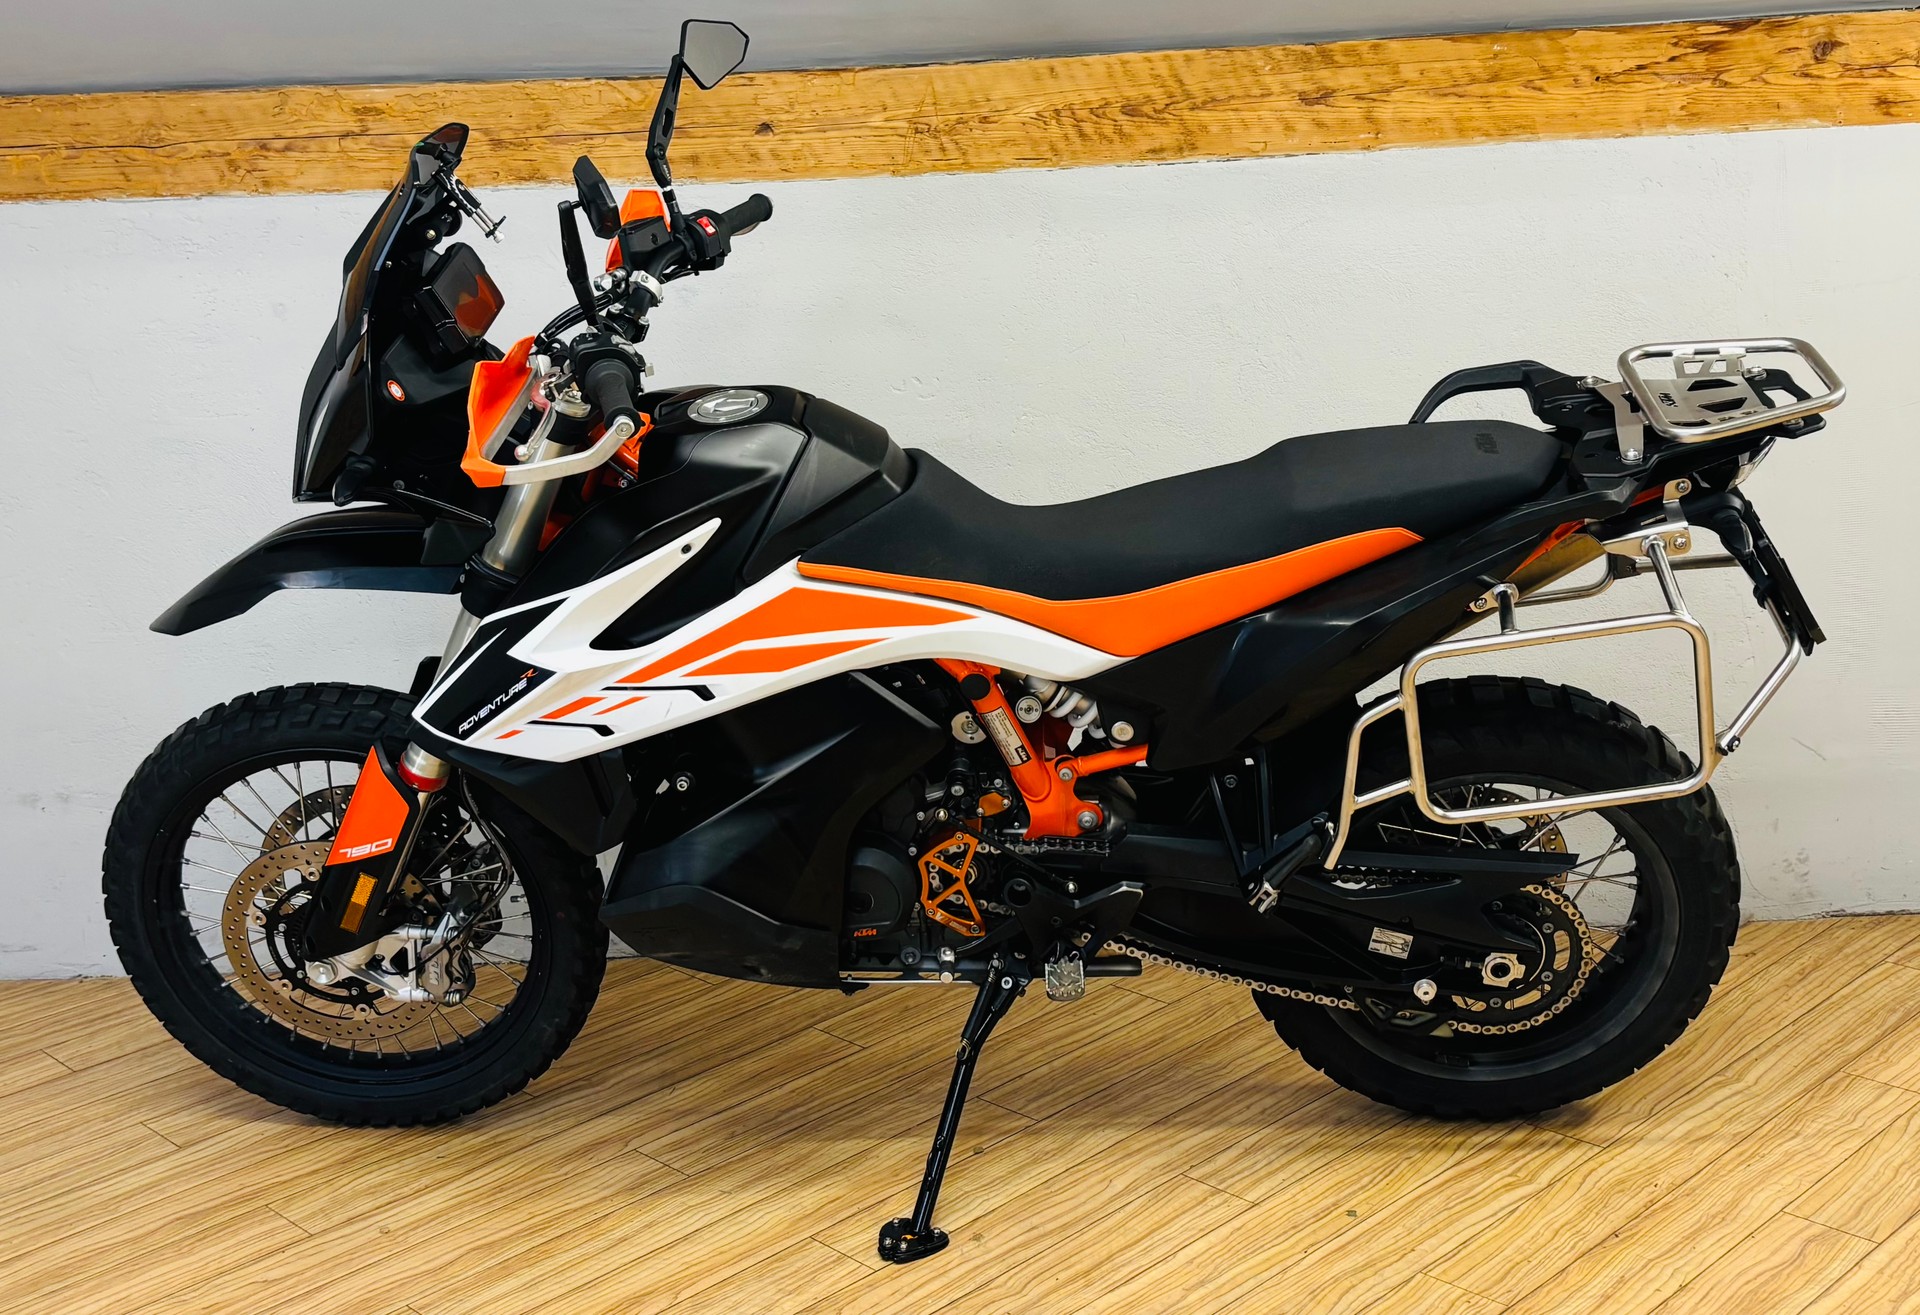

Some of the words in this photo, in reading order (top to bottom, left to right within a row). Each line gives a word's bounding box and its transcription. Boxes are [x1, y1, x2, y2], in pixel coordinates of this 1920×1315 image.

[459, 678, 527, 734] ADVENTURE
[339, 838, 393, 858] 790
[854, 928, 877, 937] KTM
